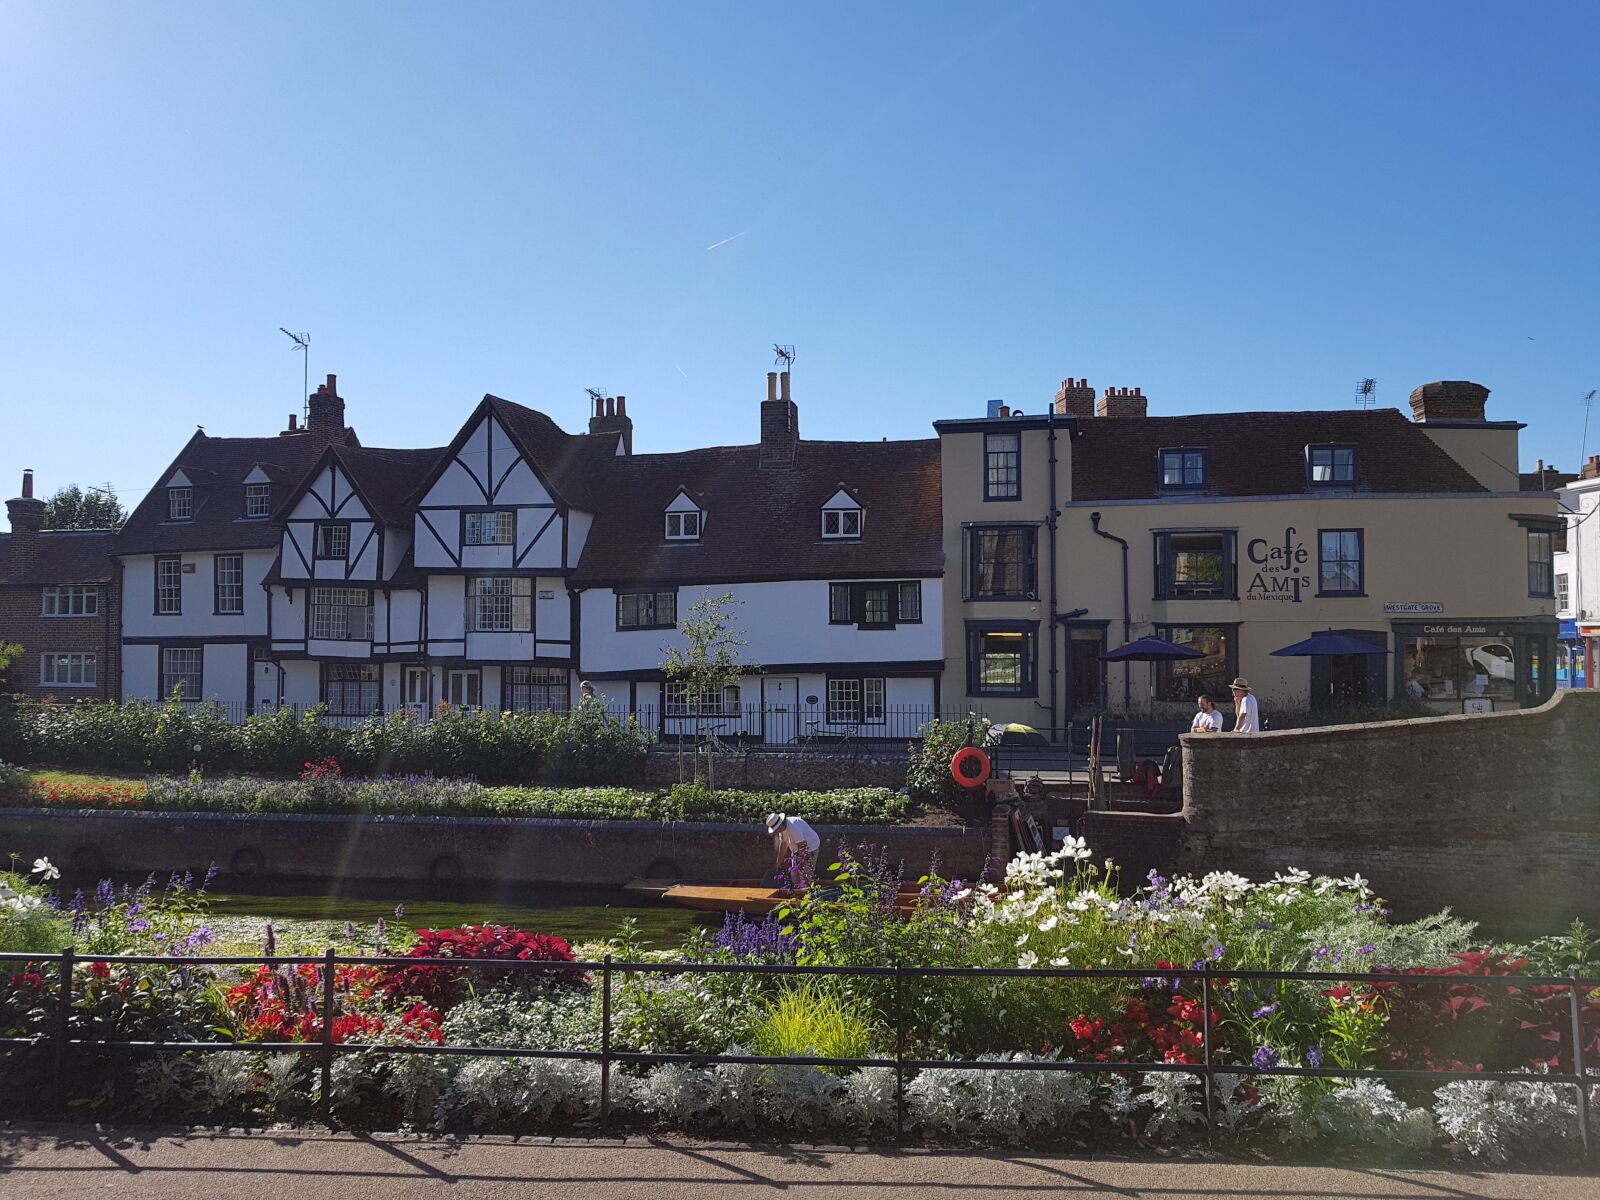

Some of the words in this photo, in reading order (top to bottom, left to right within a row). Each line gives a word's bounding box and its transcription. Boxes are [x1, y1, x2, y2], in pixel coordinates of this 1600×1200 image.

[1247, 527, 1308, 570] Café
[1261, 564, 1280, 572] des
[1246, 593, 1257, 601] du
[1258, 593, 1293, 603] Mexique
[1423, 625, 1445, 633] Café
[1447, 625, 1462, 633] des
[1464, 625, 1486, 633] Amis
